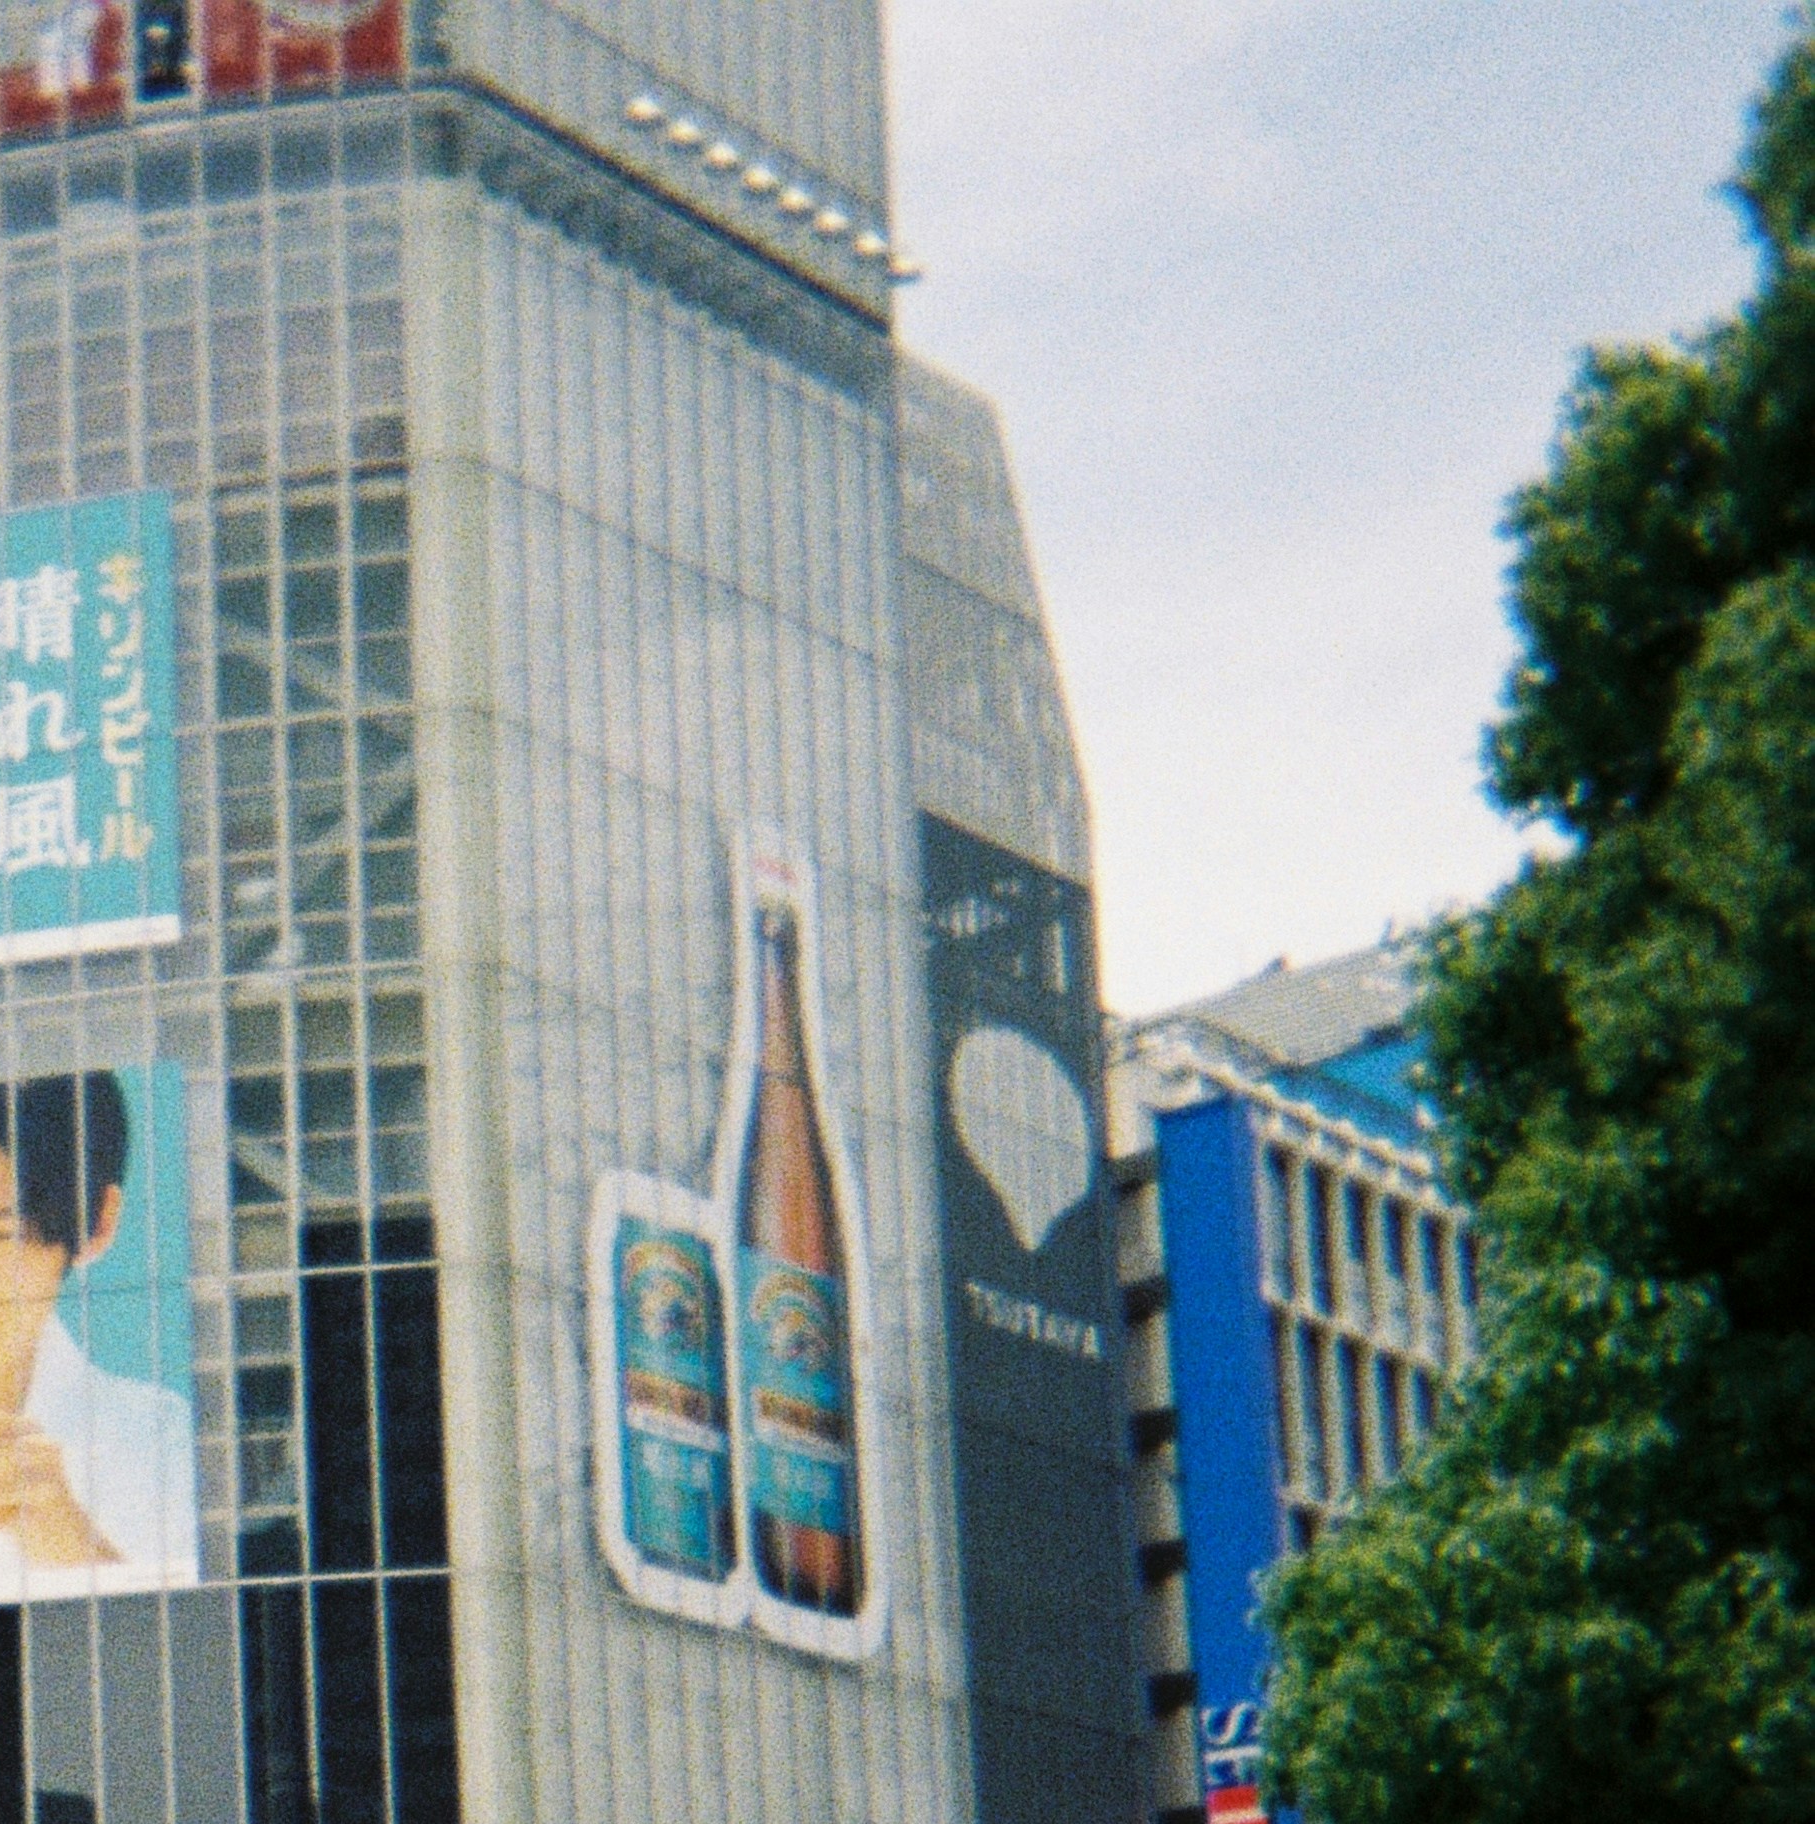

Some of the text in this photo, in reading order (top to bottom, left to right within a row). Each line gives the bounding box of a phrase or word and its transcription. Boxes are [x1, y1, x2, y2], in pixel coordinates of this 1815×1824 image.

[95, 553, 153, 862] キリンビール
